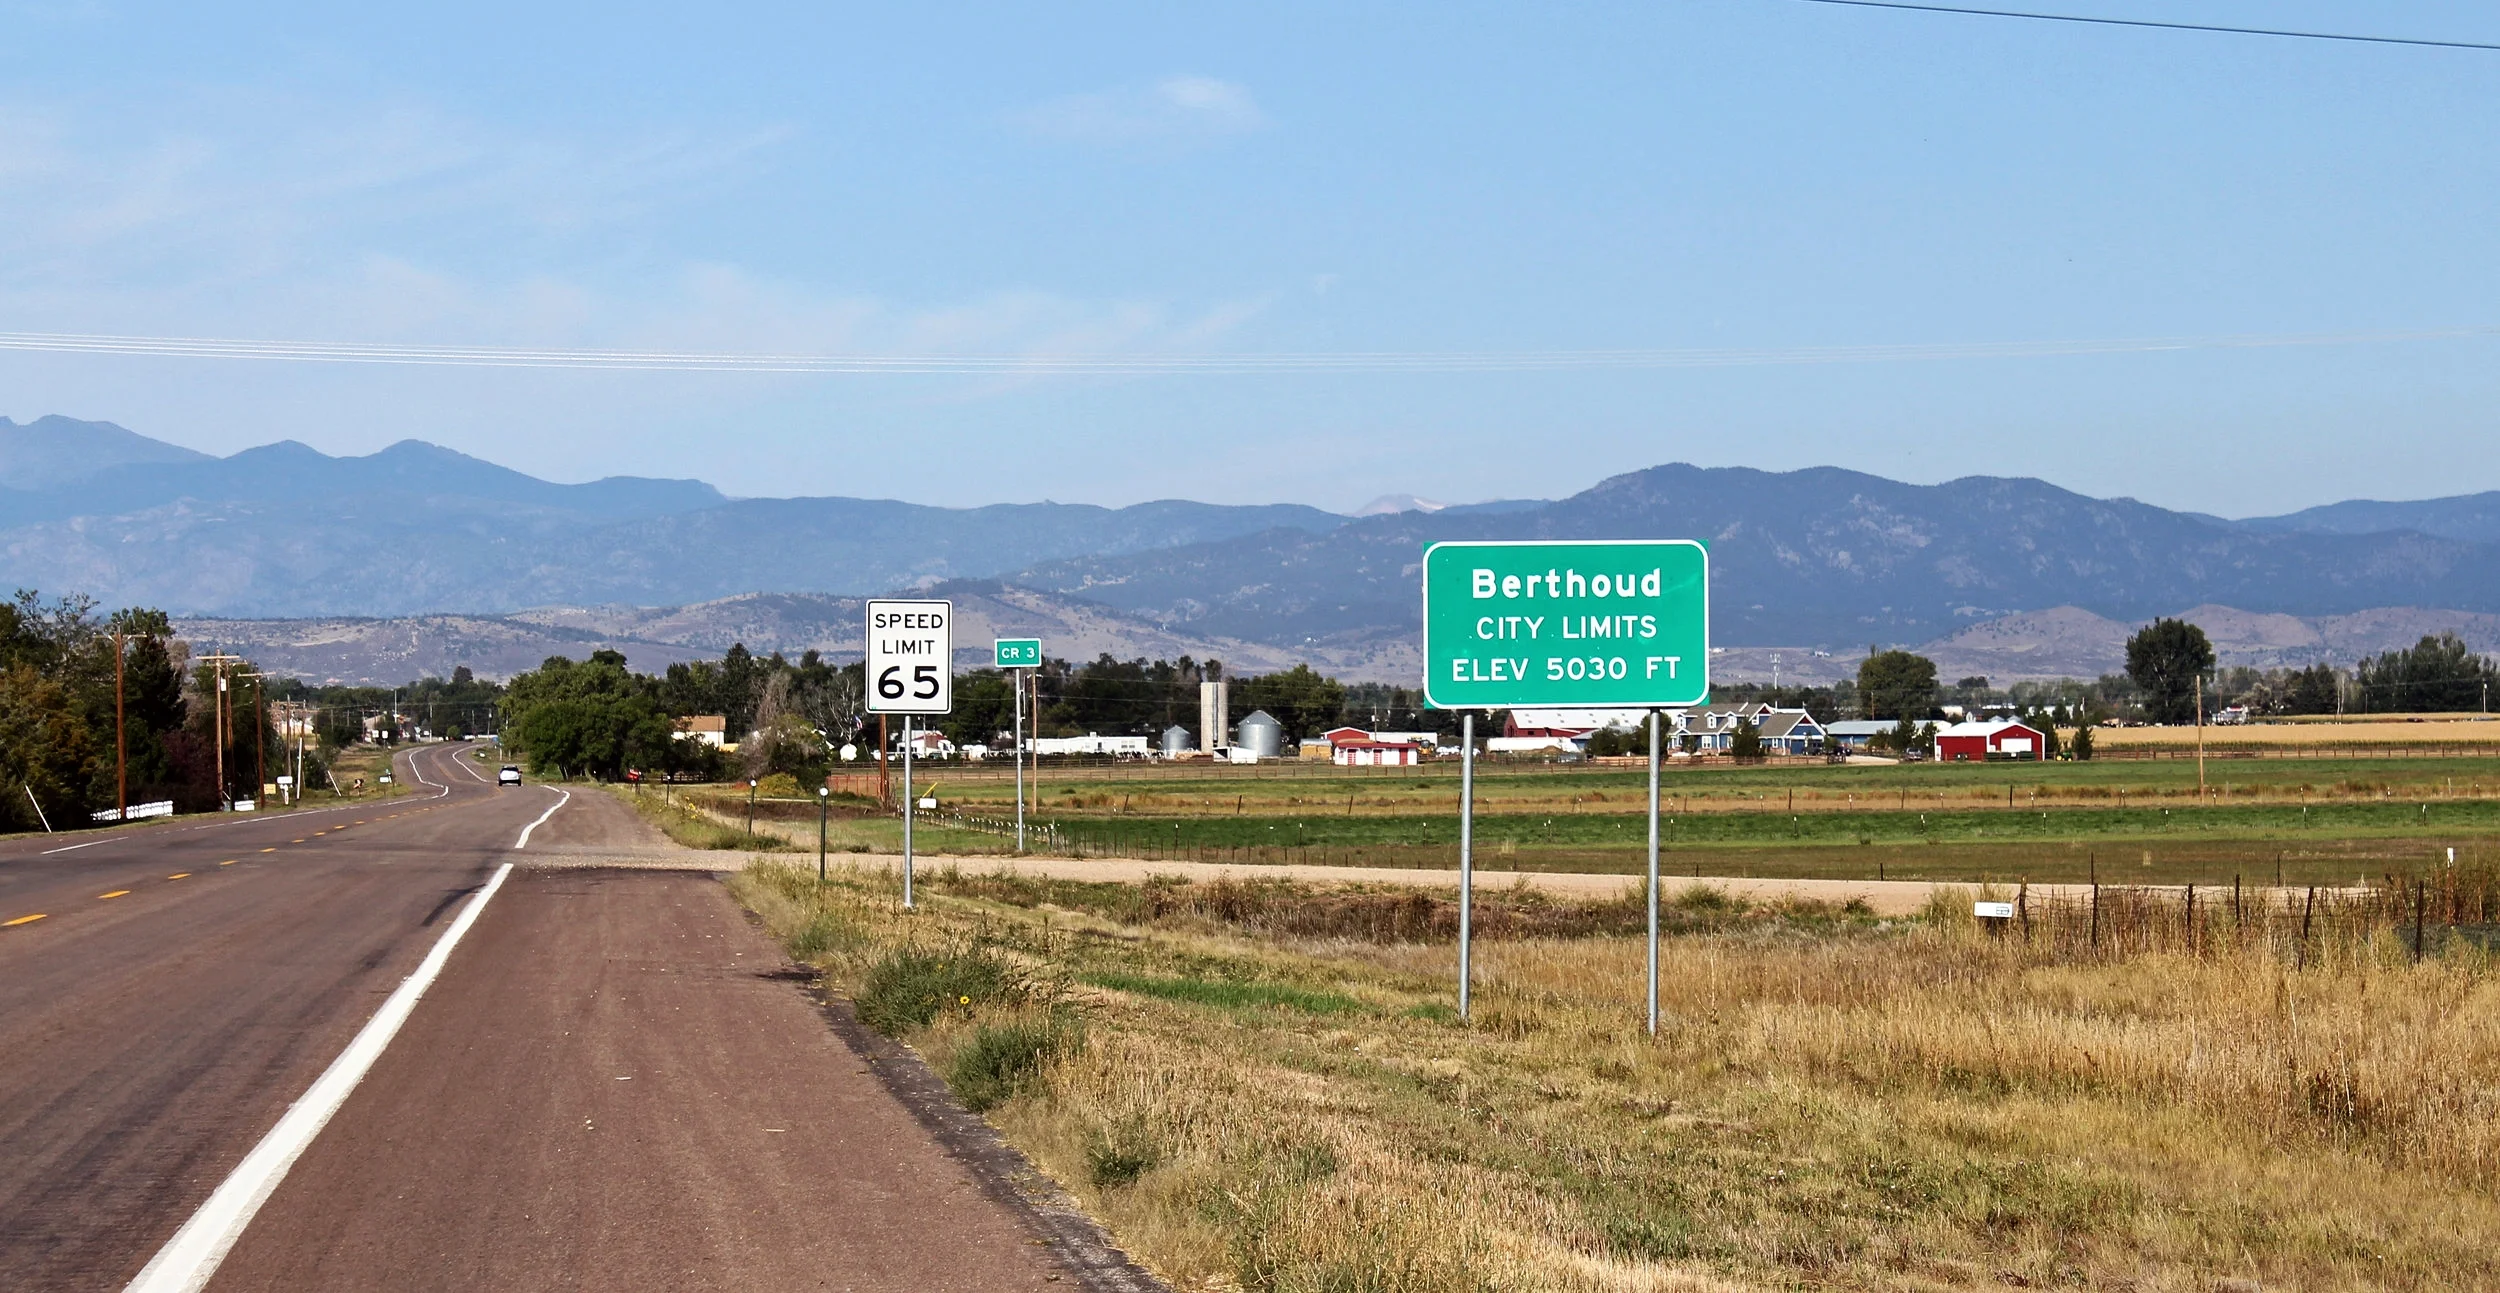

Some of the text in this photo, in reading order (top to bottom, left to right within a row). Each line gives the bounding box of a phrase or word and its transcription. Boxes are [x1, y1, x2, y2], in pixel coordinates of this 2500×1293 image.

[1472, 567, 1661, 598] Berthoud
[875, 613, 943, 629] SPEED
[1476, 615, 1657, 640] CITY LIMITS
[882, 639, 935, 655] LIMIT
[1001, 646, 1035, 659] CR 3
[1452, 656, 1681, 682] ELEV 5030 FT
[877, 665, 940, 700] 65
